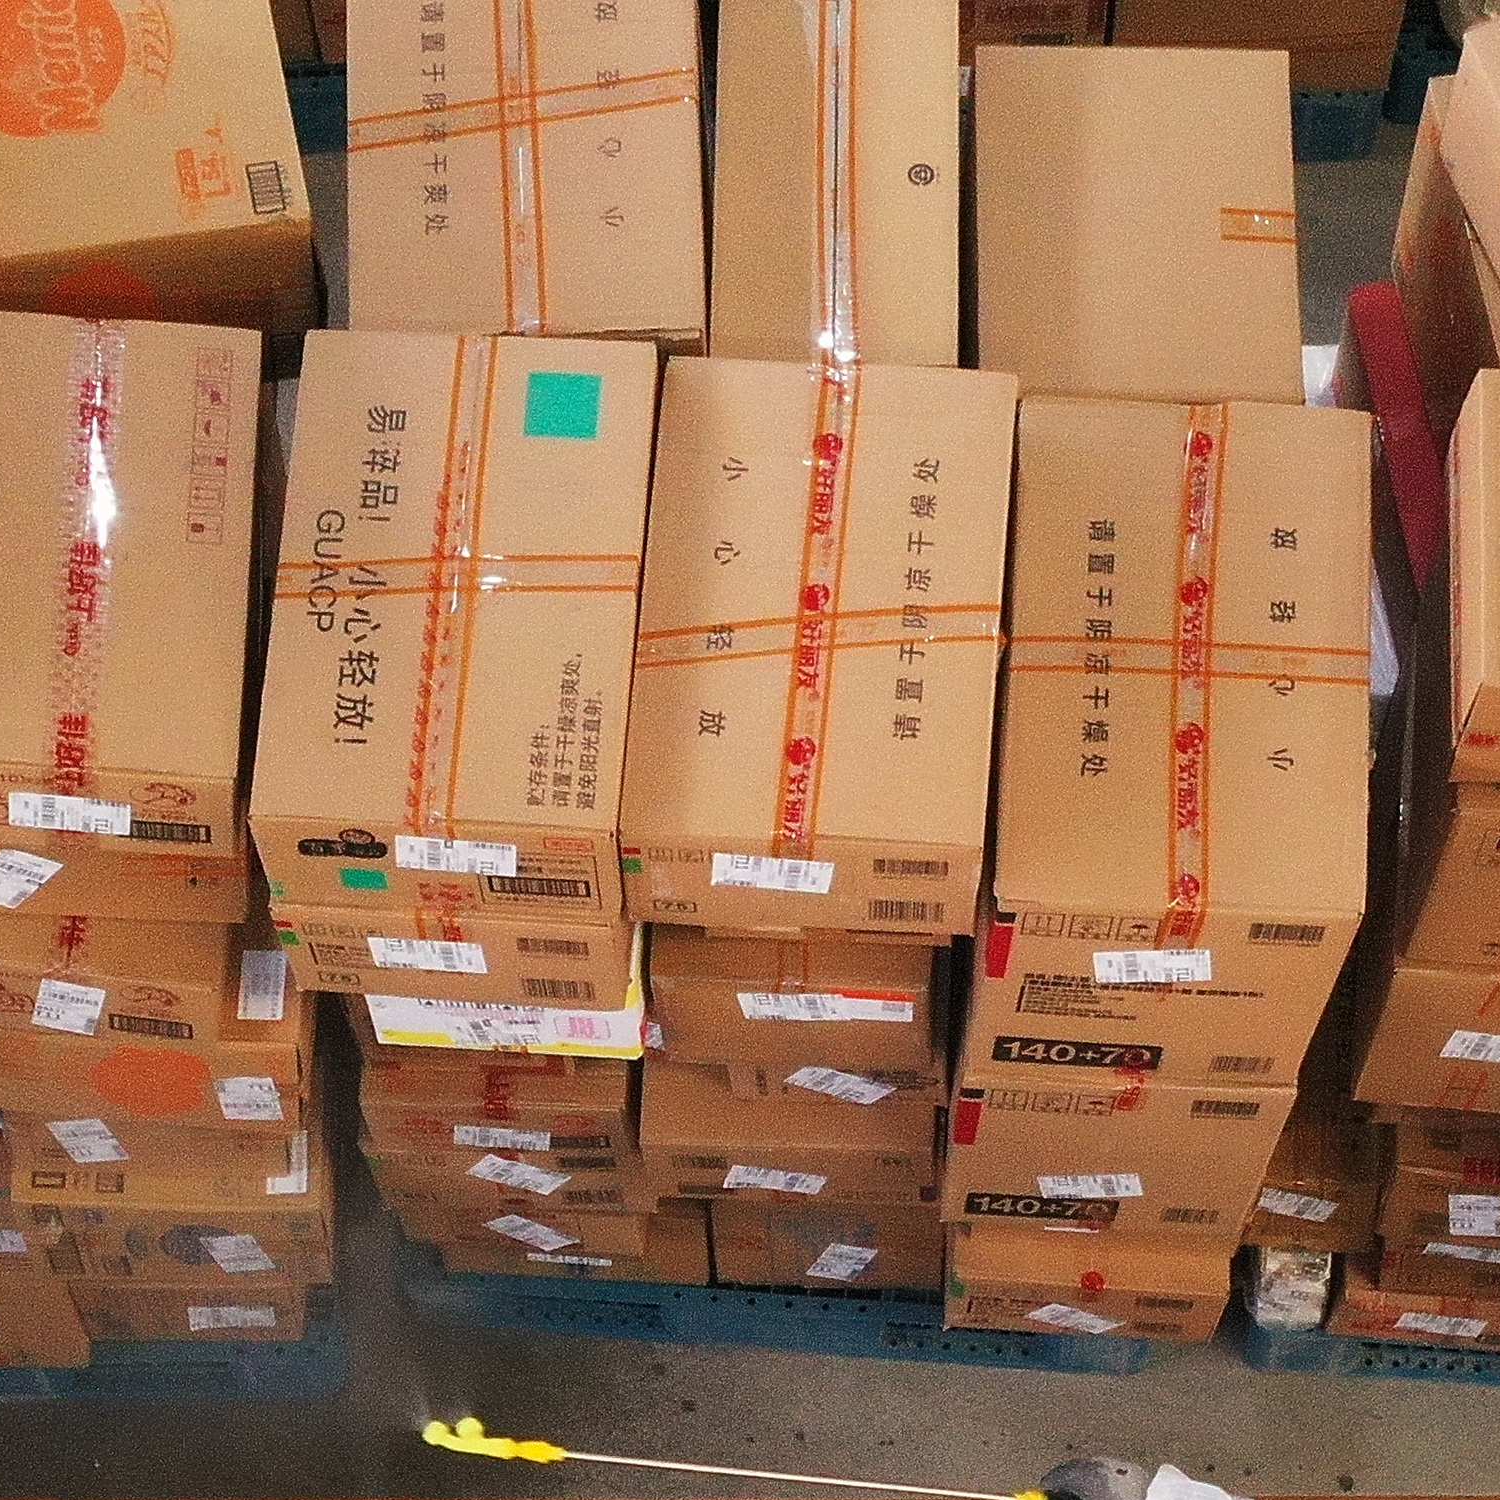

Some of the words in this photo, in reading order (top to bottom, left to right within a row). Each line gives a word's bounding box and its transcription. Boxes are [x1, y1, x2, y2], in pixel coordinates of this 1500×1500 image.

[811, 464, 837, 536] 好丽友
[306, 508, 347, 633] GUACP
[698, 457, 748, 738] 小心轻放
[890, 457, 941, 741] 请置于阴凉干燥处
[332, 566, 388, 748] 小心轻放!
[797, 619, 825, 690] 好丽友
[1079, 518, 1117, 777] 请置于阴凉干燥处
[1181, 606, 1206, 679] 好丽友
[1266, 525, 1300, 773] 小心轻放
[1176, 749, 1202, 829] 好丽友
[1002, 1040, 1153, 1066] 140+70
